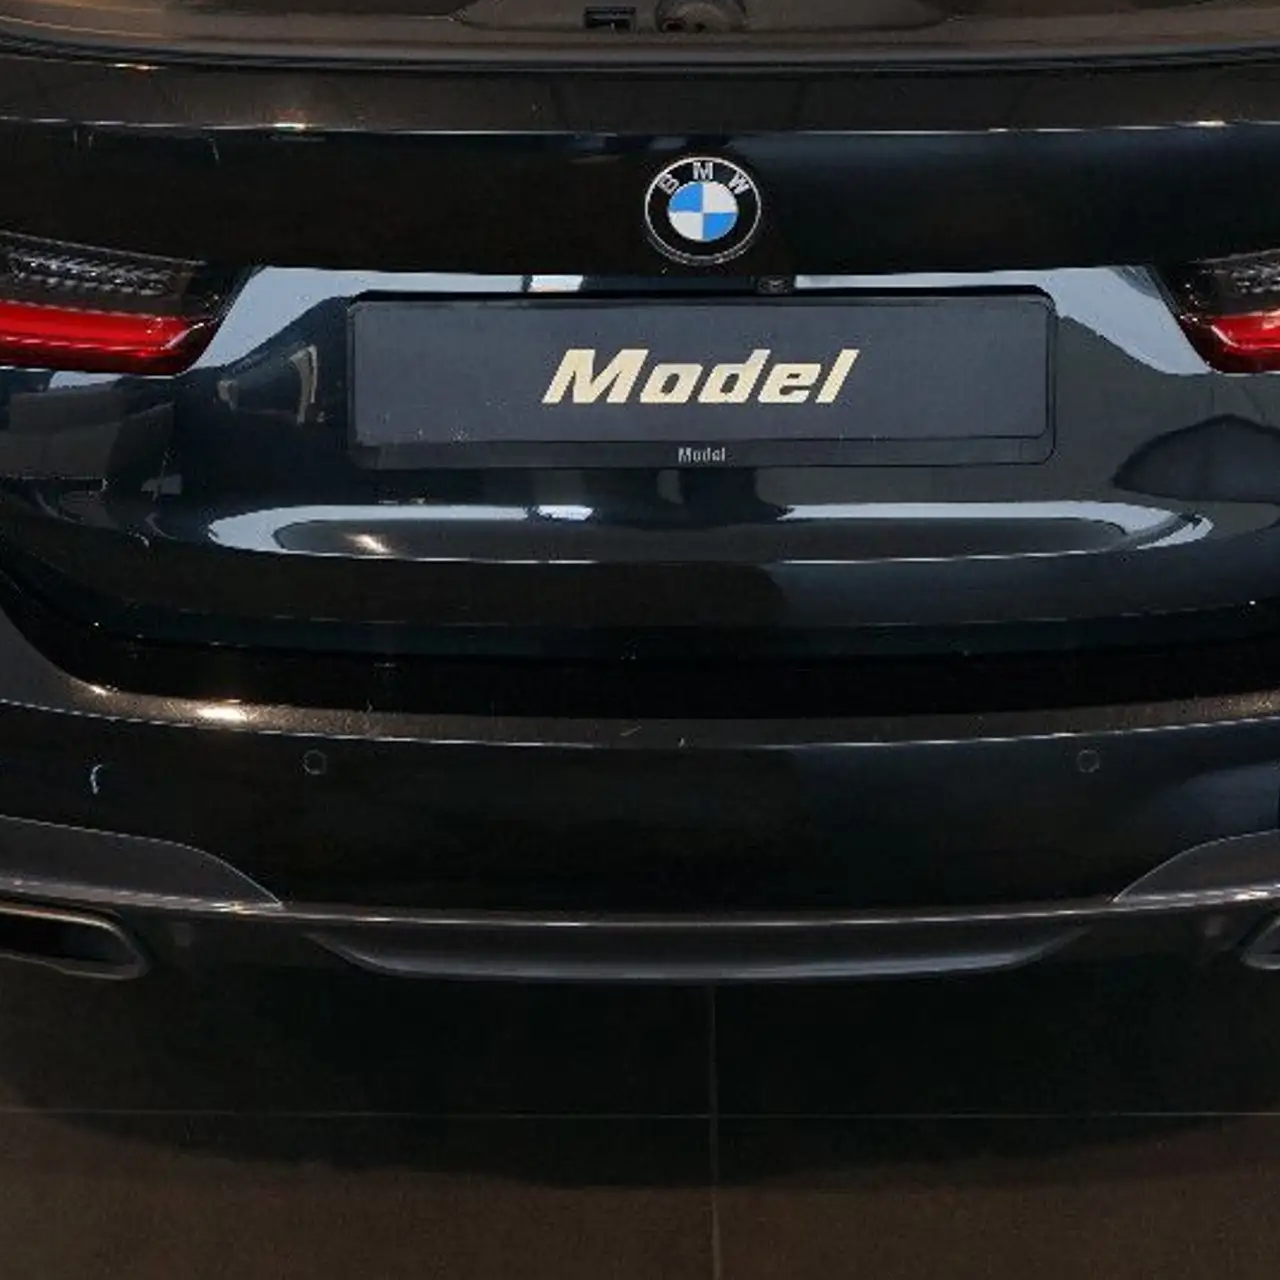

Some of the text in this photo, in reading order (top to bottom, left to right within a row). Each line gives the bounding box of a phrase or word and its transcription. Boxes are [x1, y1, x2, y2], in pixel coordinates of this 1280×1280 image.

[657, 161, 752, 195] BMW
[542, 348, 860, 404] Model
[678, 447, 726, 463] Model
